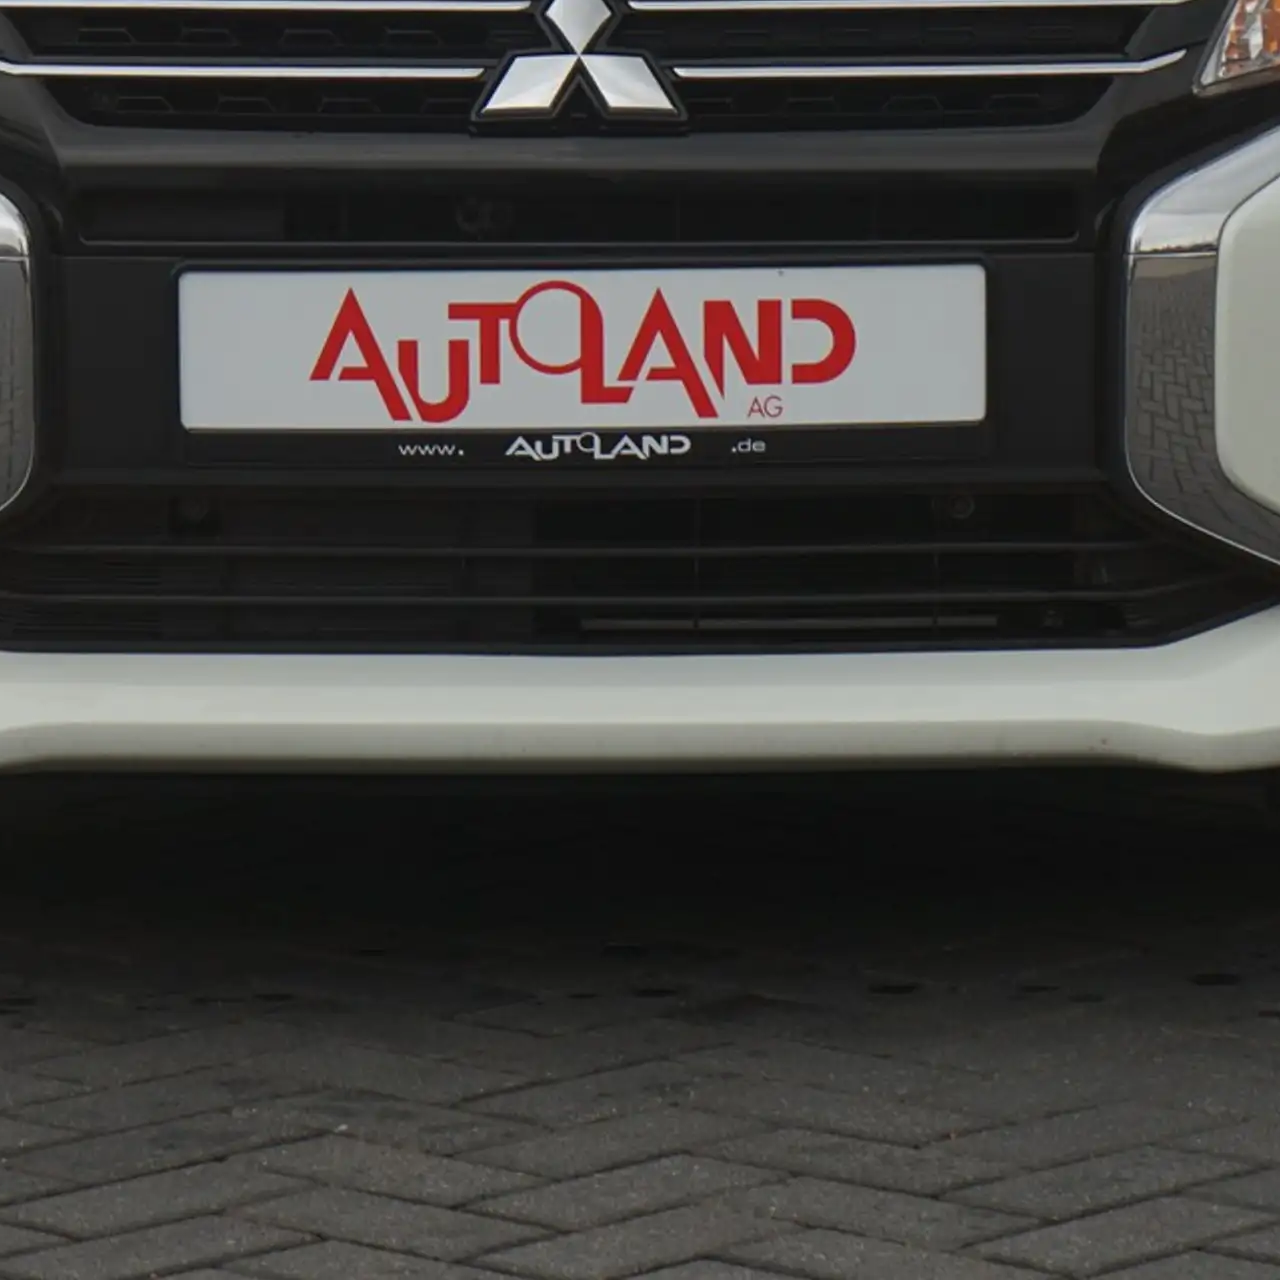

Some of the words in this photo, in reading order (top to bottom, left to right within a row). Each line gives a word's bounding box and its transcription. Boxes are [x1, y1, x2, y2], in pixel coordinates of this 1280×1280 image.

[310, 280, 857, 423] AUTOLAND
[746, 394, 784, 419] AG
[398, 442, 465, 457] www.
[504, 431, 692, 462] AUTOLAND
[730, 437, 767, 454] .de
